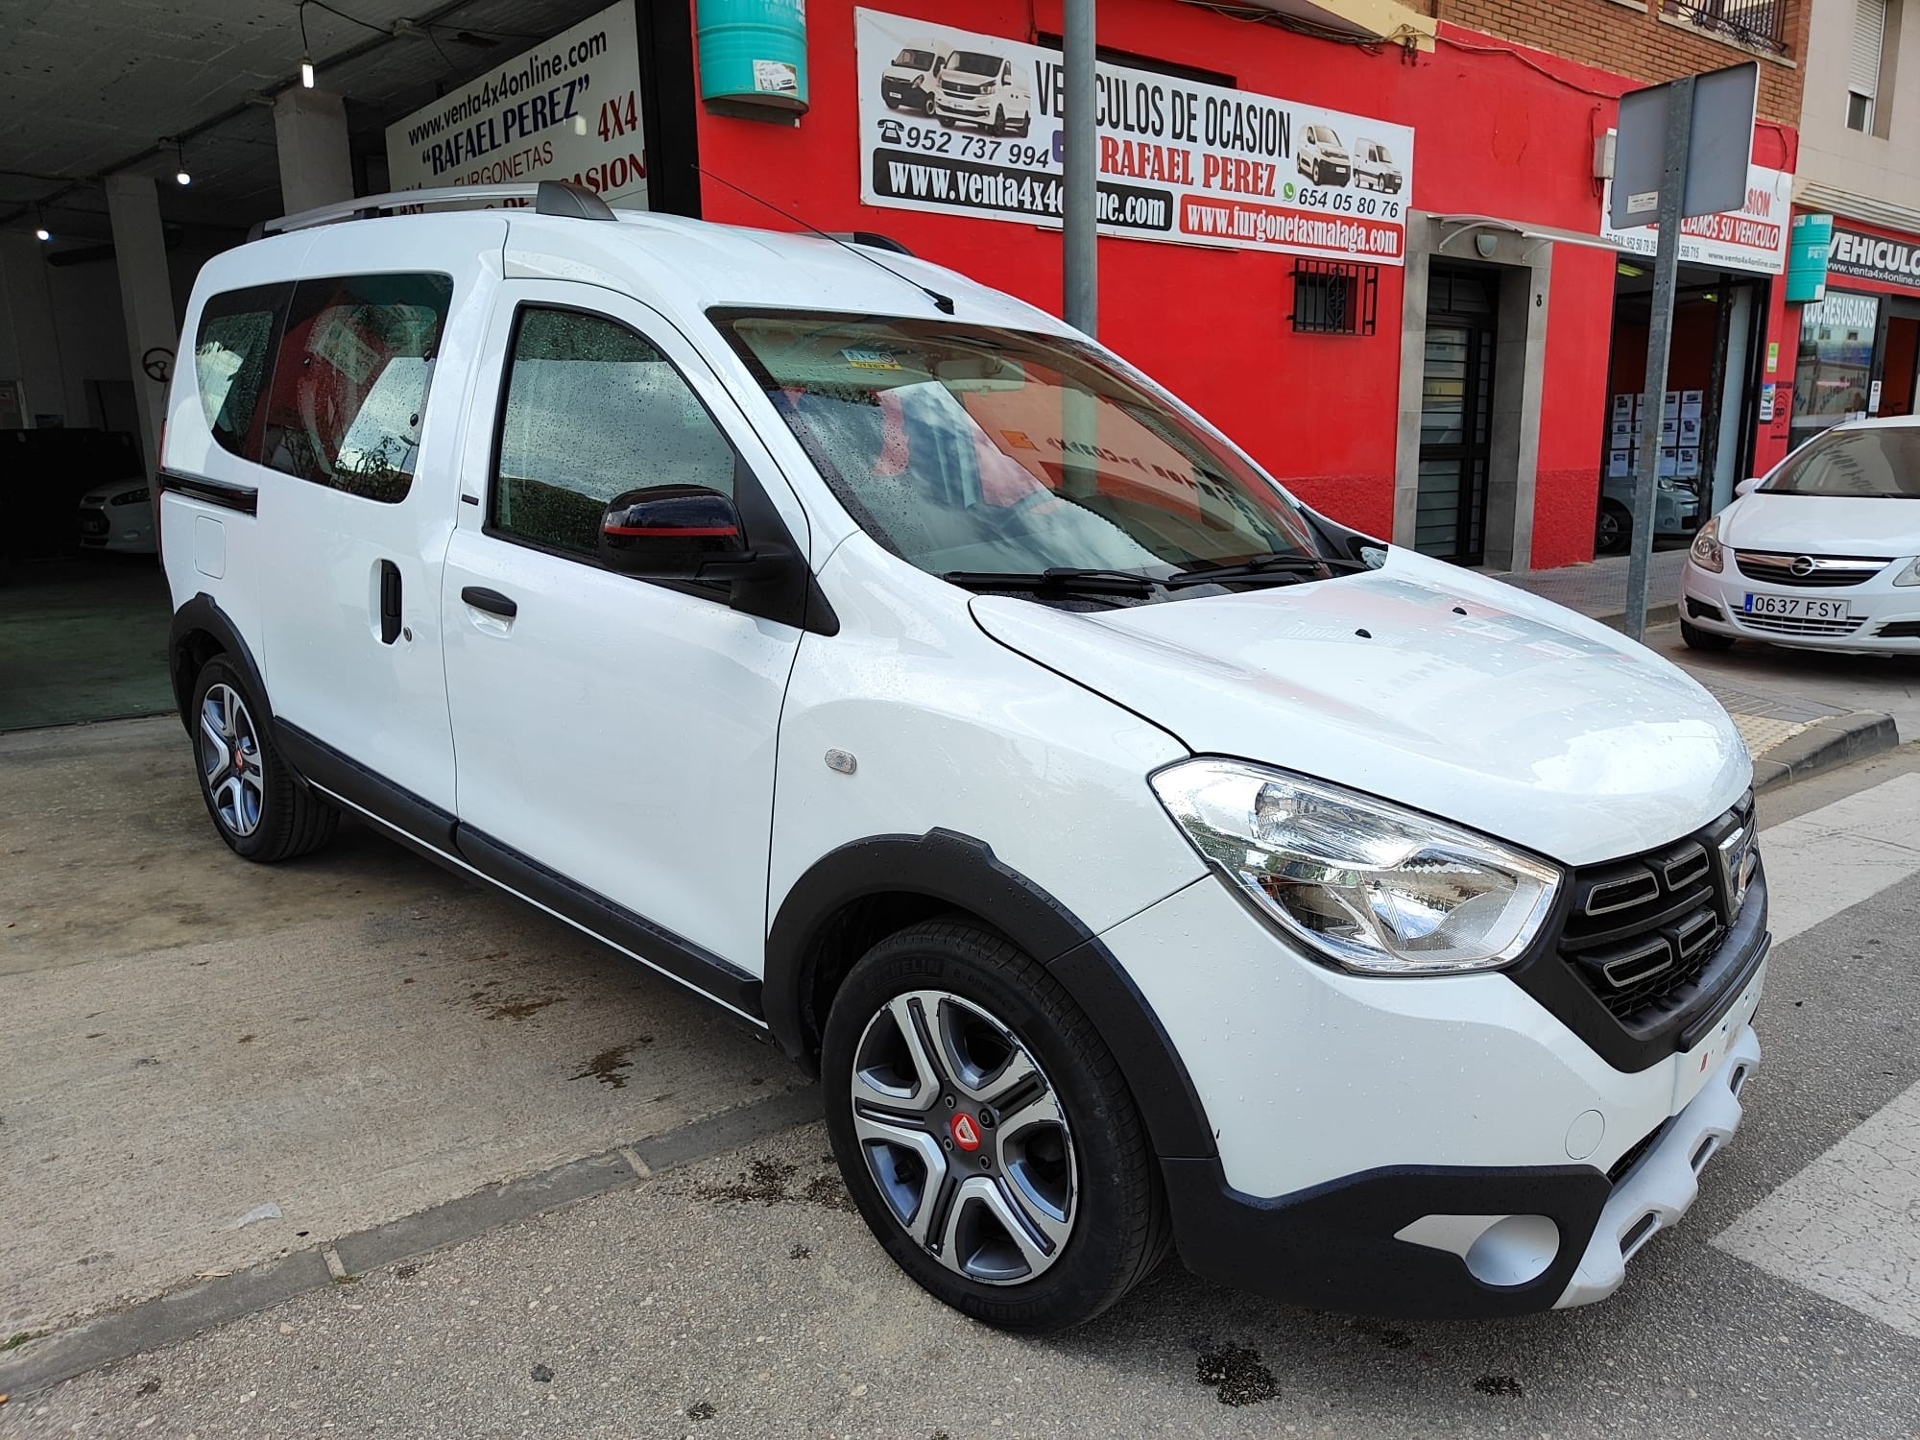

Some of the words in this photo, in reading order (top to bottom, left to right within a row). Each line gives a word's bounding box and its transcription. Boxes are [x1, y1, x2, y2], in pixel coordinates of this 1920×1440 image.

[408, 30, 607, 147] www.venta4x4online.com
[1035, 59, 1164, 137] VECULOS
[1171, 88, 1198, 143] DE
[1204, 95, 1291, 159] OCASION
[597, 90, 638, 142] 4X4
[905, 126, 952, 153] 952
[961, 134, 1002, 161] 737
[1008, 143, 1049, 168] 994
[1100, 135, 1194, 186] RAFAEL
[1202, 152, 1276, 197] PEREZ
[560, 149, 647, 195] SION
[888, 160, 1165, 228] www.venta4x4ne.com
[1299, 187, 1328, 208] 654
[1332, 192, 1352, 212] 05
[1356, 197, 1376, 215] 80
[1381, 200, 1399, 218] 76
[1743, 187, 1771, 218] SION
[1187, 203, 1398, 254] www.furgonetasmalaga.com
[1720, 219, 1732, 241] SU
[1735, 222, 1779, 249] VEHICULO
[1754, 597, 1800, 615] 0637
[1806, 601, 1843, 619] FSY
